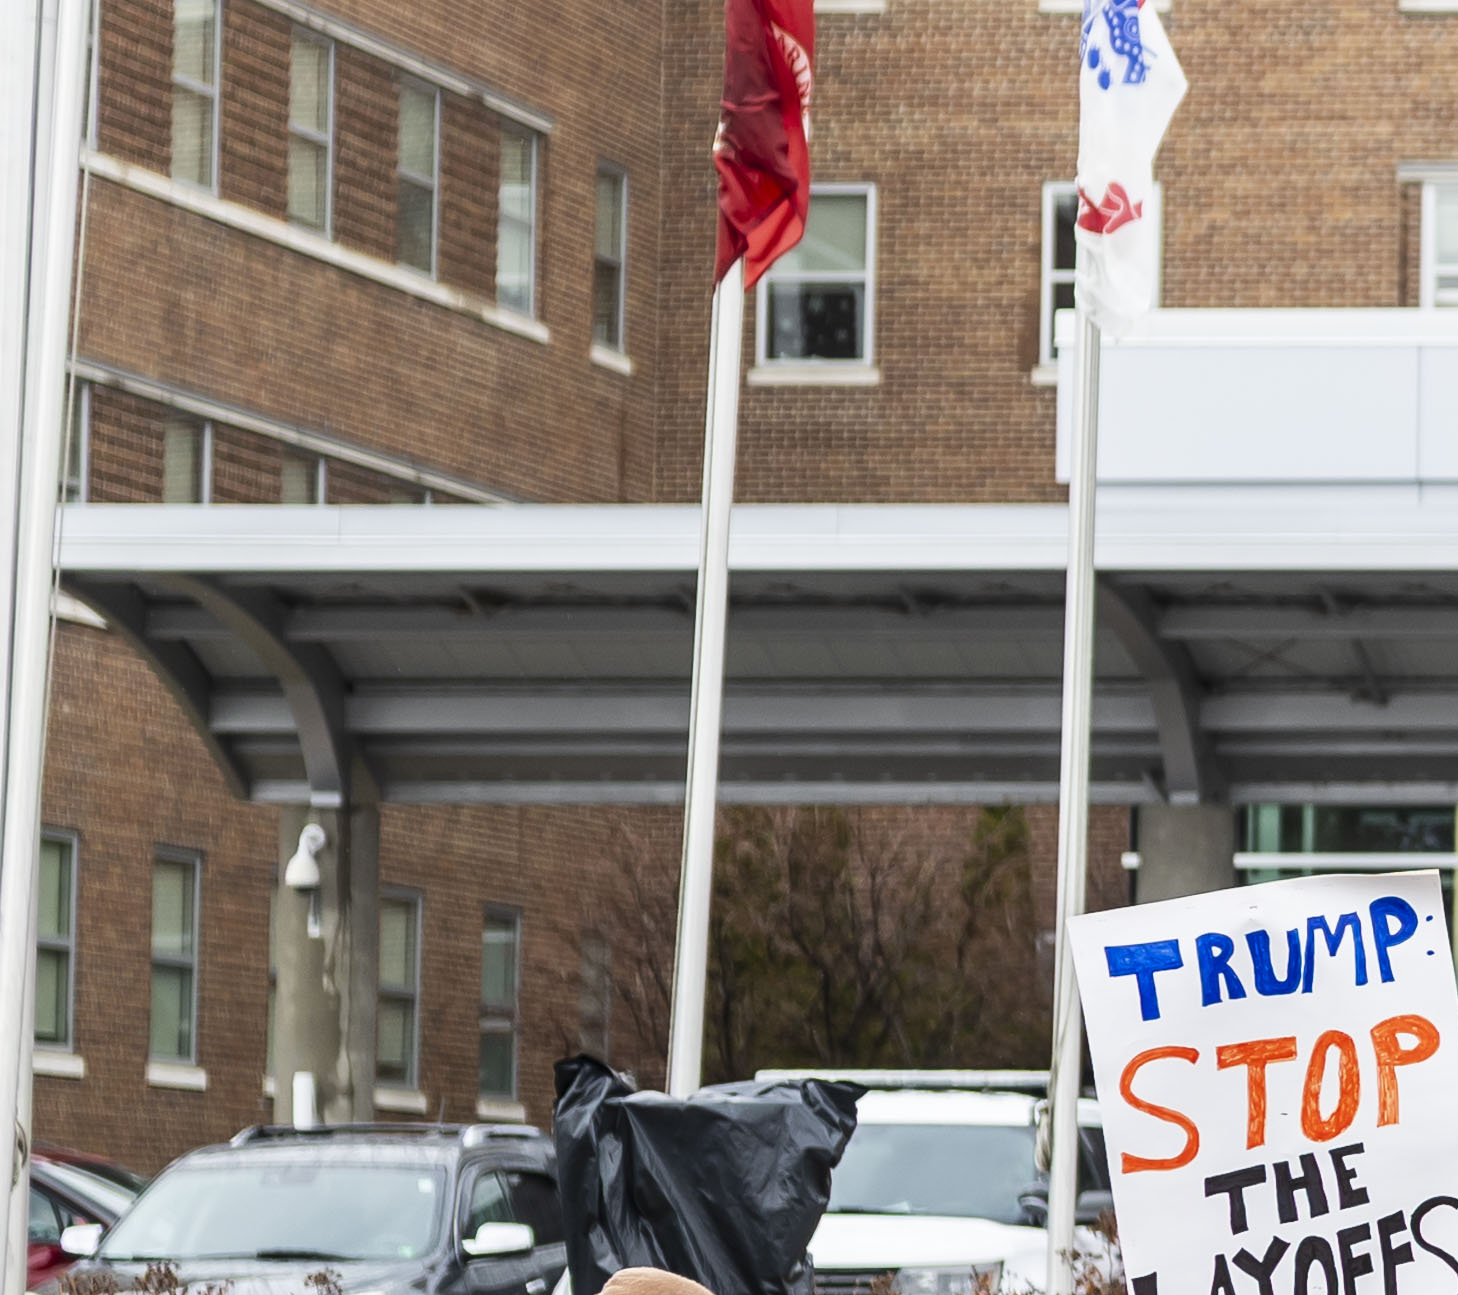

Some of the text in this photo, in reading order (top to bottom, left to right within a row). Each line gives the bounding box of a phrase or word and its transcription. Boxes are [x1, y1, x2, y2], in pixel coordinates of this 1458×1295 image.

[1104, 895, 1436, 1021] TRUMP:
[1119, 1014, 1441, 1175] STOP
[1204, 1142, 1370, 1235] THE
